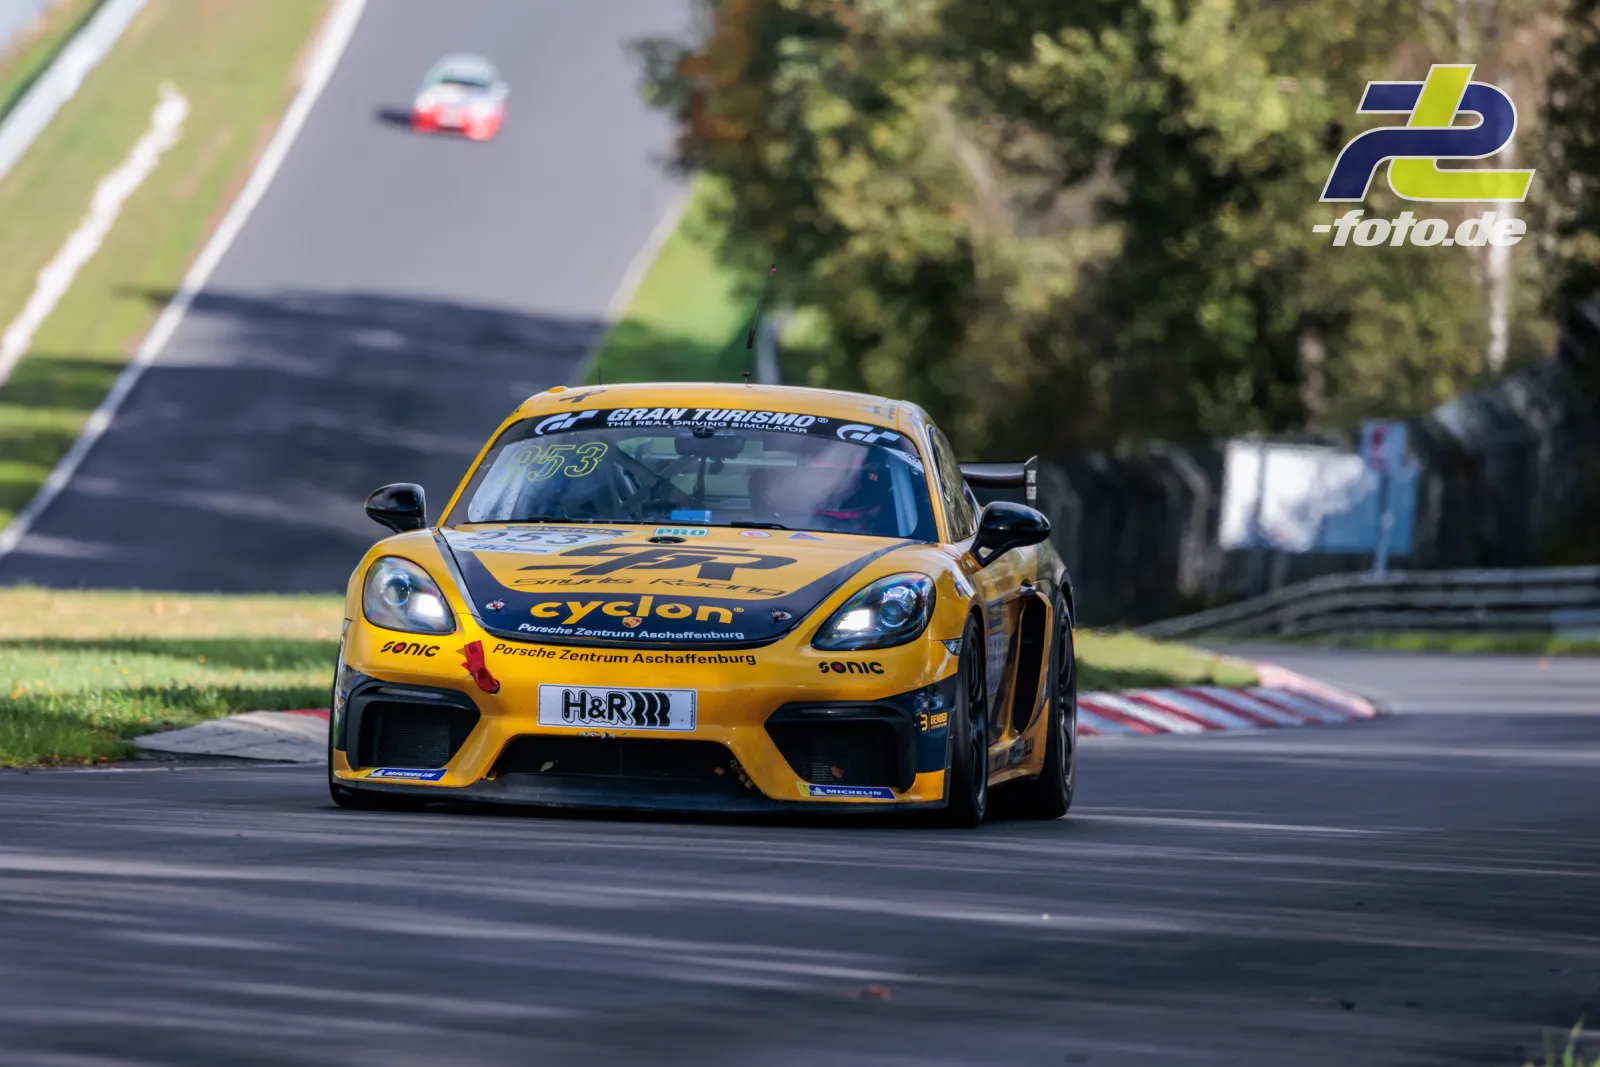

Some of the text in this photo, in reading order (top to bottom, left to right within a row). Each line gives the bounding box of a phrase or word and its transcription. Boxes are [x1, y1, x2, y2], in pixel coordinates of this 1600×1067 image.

[606, 408, 689, 422] GRAN
[635, 419, 670, 427] REAL
[672, 420, 727, 428] DRIVING
[730, 422, 808, 433] SIMULATOR
[467, 531, 588, 545] 953
[656, 528, 706, 536] PRO
[649, 578, 787, 597] Racing
[518, 623, 745, 640] Porsche Zentrum Aschaffenburg
[492, 643, 757, 666] Porsche Zentrum Aschaffenburg
[562, 689, 633, 726] H&R
[826, 788, 882, 796] MICHELIN
